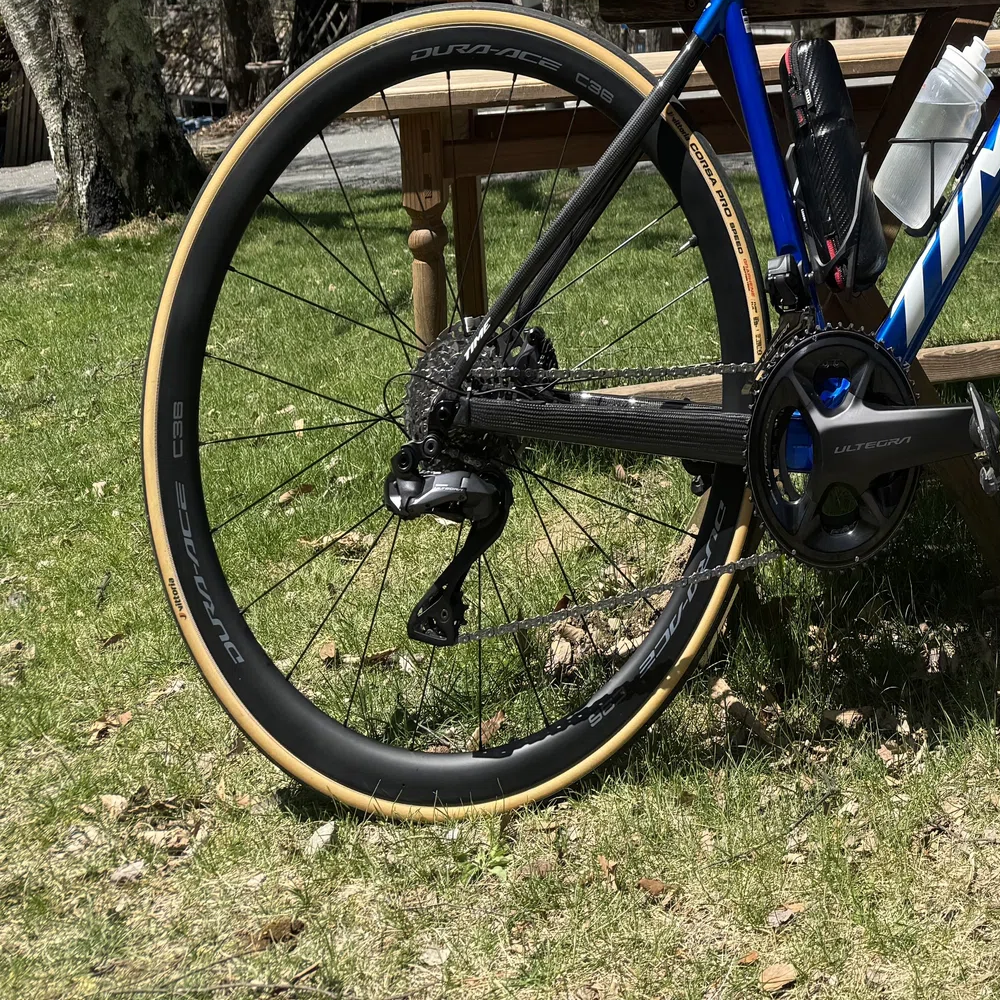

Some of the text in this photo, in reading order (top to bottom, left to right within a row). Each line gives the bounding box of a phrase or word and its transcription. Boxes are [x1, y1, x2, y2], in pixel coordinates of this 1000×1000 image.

[410, 43, 614, 104] DURA-ACE C36
[690, 142, 718, 187] CORSA
[716, 189, 732, 218] PRO
[729, 222, 743, 255] SPEED
[463, 316, 492, 361] TIME
[833, 436, 912, 455] ULTEGRA
[172, 400, 245, 665] DURA-ACE C36
[168, 576, 186, 613] vittoria
